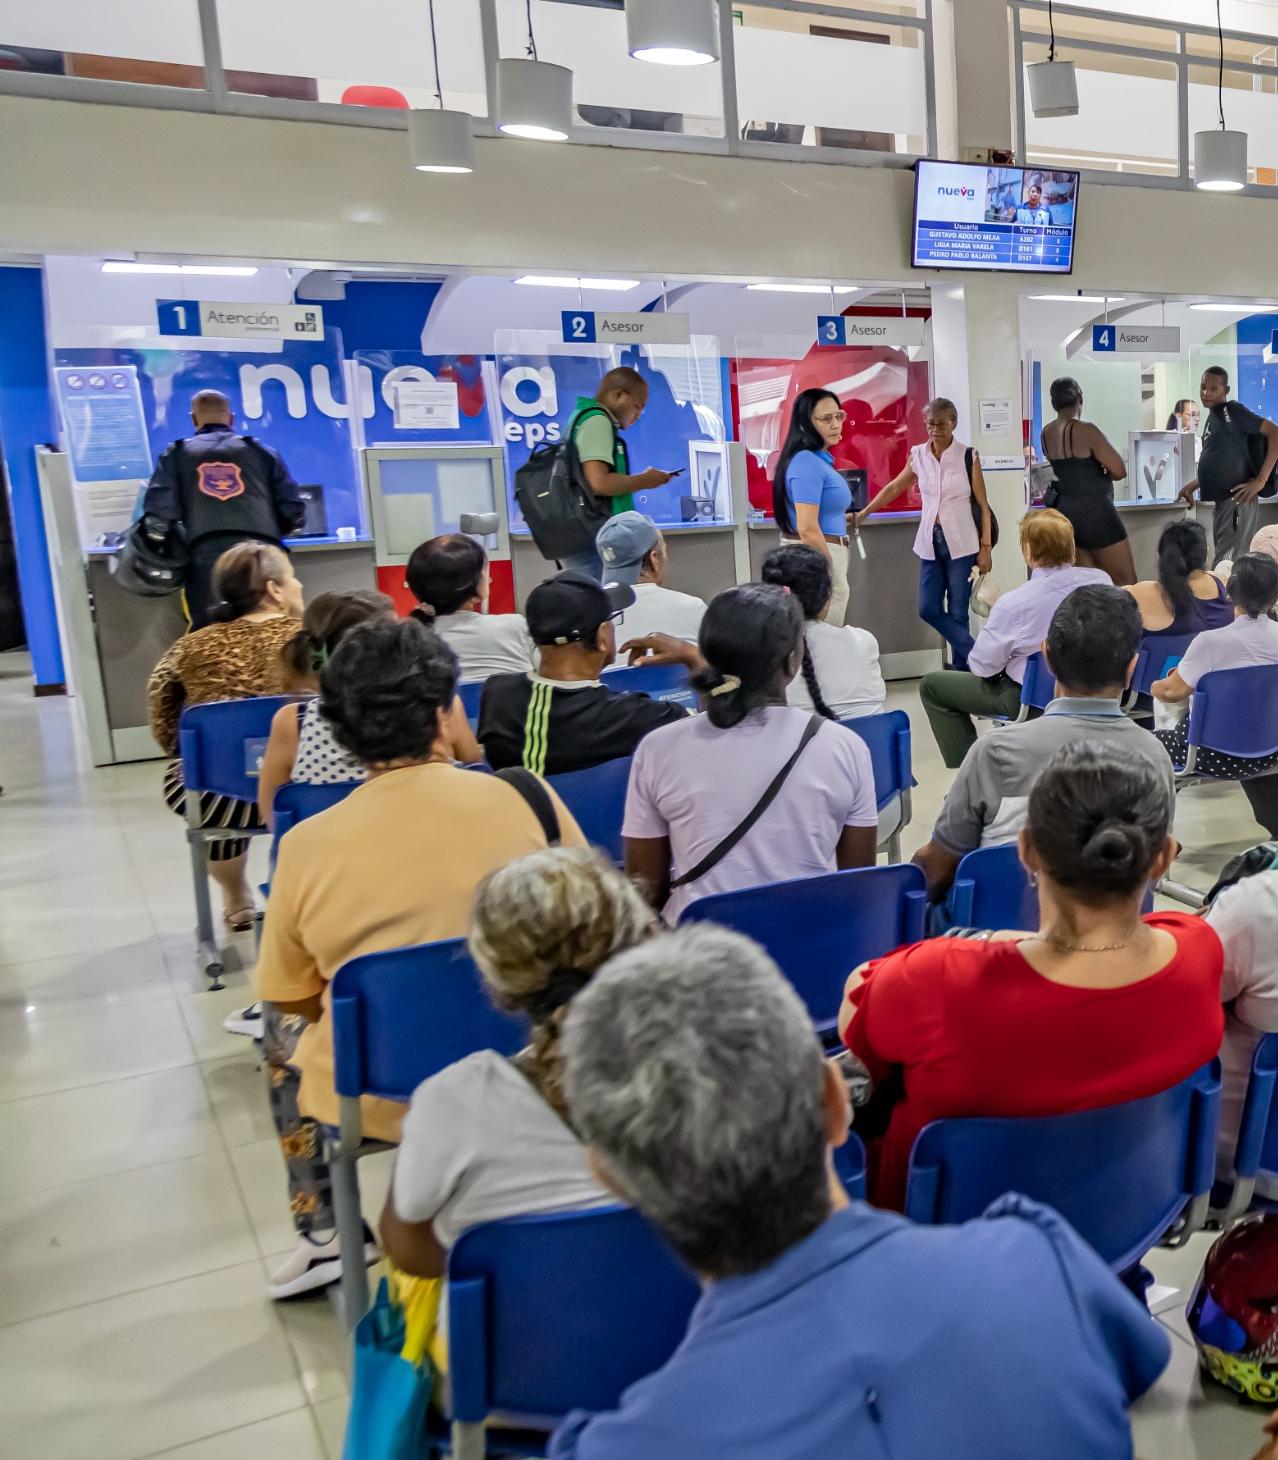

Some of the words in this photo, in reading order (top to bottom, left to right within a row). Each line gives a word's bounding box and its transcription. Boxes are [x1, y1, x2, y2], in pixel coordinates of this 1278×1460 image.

[938, 186, 974, 197] nueva
[929, 231, 957, 239] GUSTAVO
[954, 222, 979, 231] Usuario
[1020, 226, 1038, 234] Turno
[1046, 228, 1068, 236] Módulo
[173, 306, 187, 330] 1
[207, 310, 280, 326] Atención
[572, 316, 587, 338] 2
[601, 320, 644, 333] Asesor
[826, 321, 838, 340] 3
[851, 324, 887, 336] Asesor
[1098, 329, 1110, 347] 4
[1119, 332, 1149, 343] Asesor
[504, 420, 561, 450] eps
